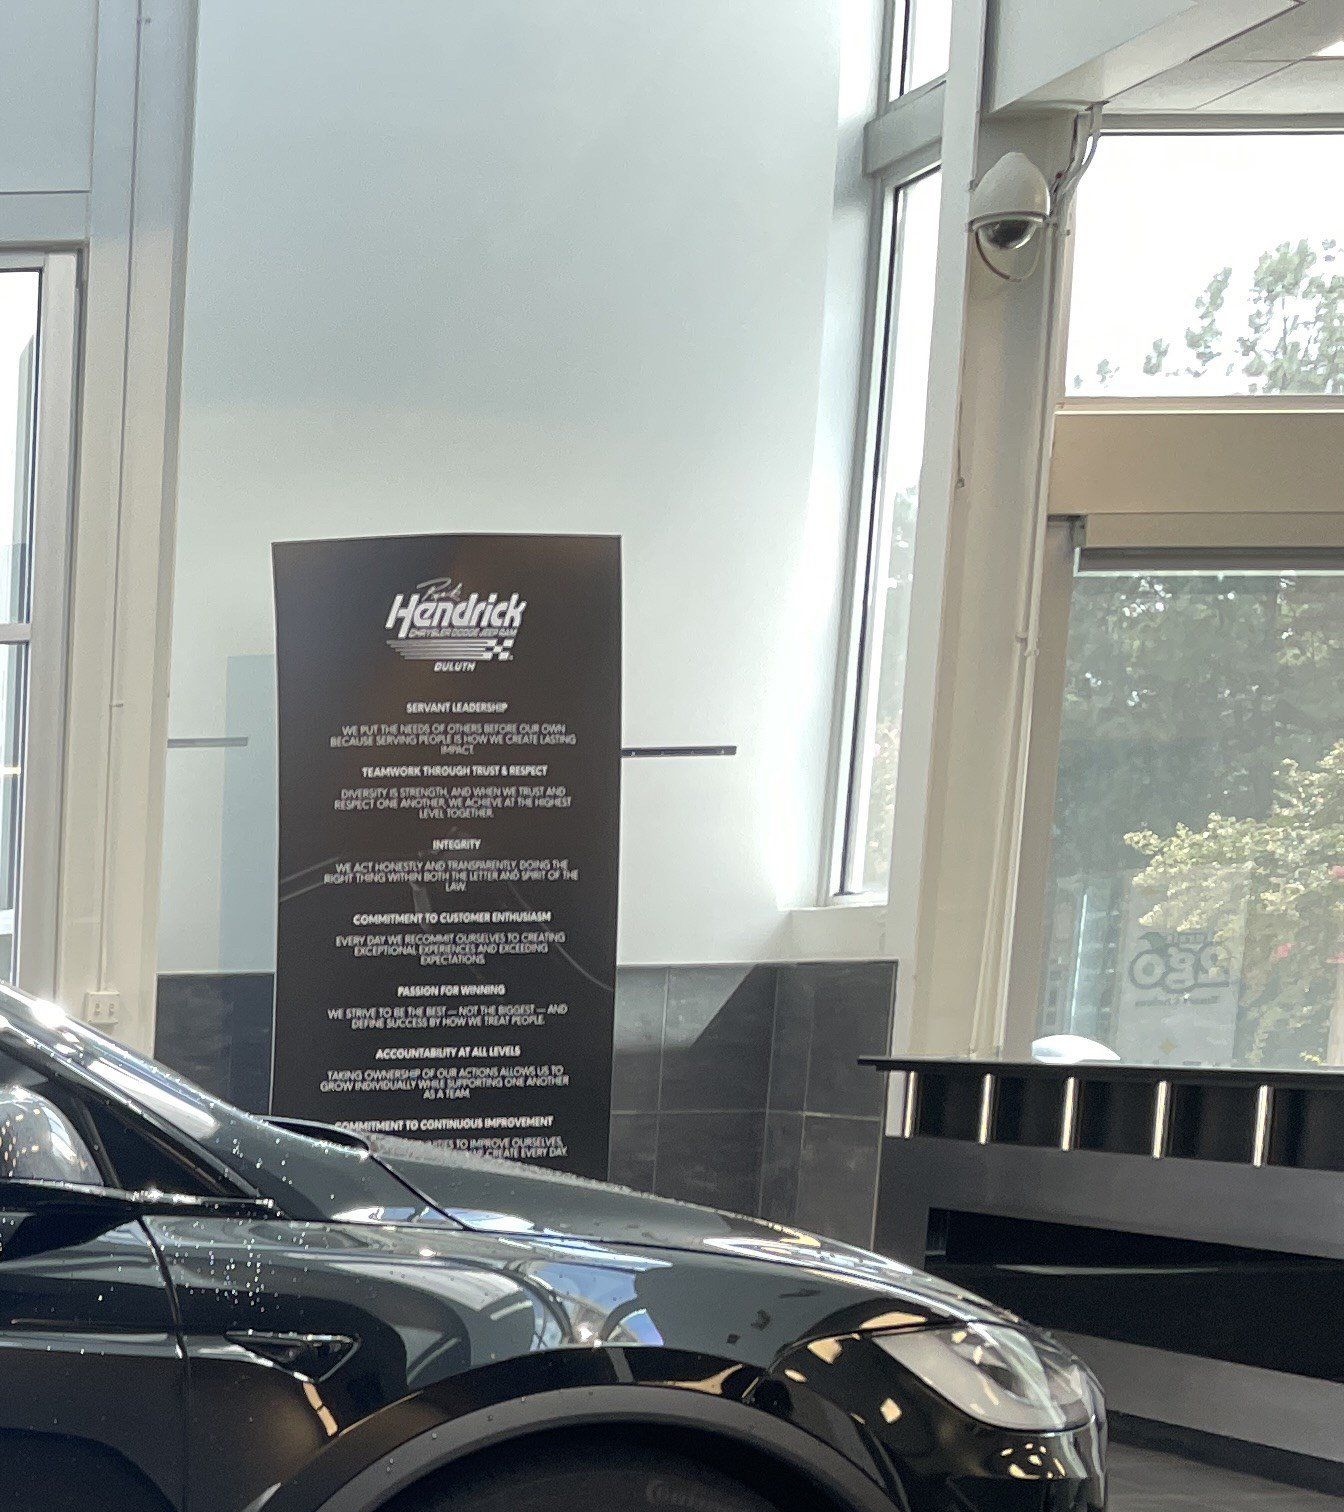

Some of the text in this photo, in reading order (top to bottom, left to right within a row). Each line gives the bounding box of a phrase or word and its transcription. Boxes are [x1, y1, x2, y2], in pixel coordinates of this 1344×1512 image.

[385, 592, 528, 639] Hendrick
[434, 661, 476, 672] DULUTH
[406, 702, 508, 714] SERVANT LEADERSHIP
[362, 765, 548, 778] TEAMWORK THROUGH TRUST & RESPECT
[433, 839, 482, 850] INTEGRITY
[353, 911, 552, 925] COMMITMENT TO CUSTOMER ENTHUSIASM
[397, 984, 506, 997] PASSION FOR WINNING
[375, 1045, 521, 1060] ACCOUNTABILITY AT ALL LEVELS
[406, 1119, 419, 1130] TO
[420, 1117, 483, 1130] CONTINUOUS
[484, 1115, 554, 1129] IMPROVEMENT
